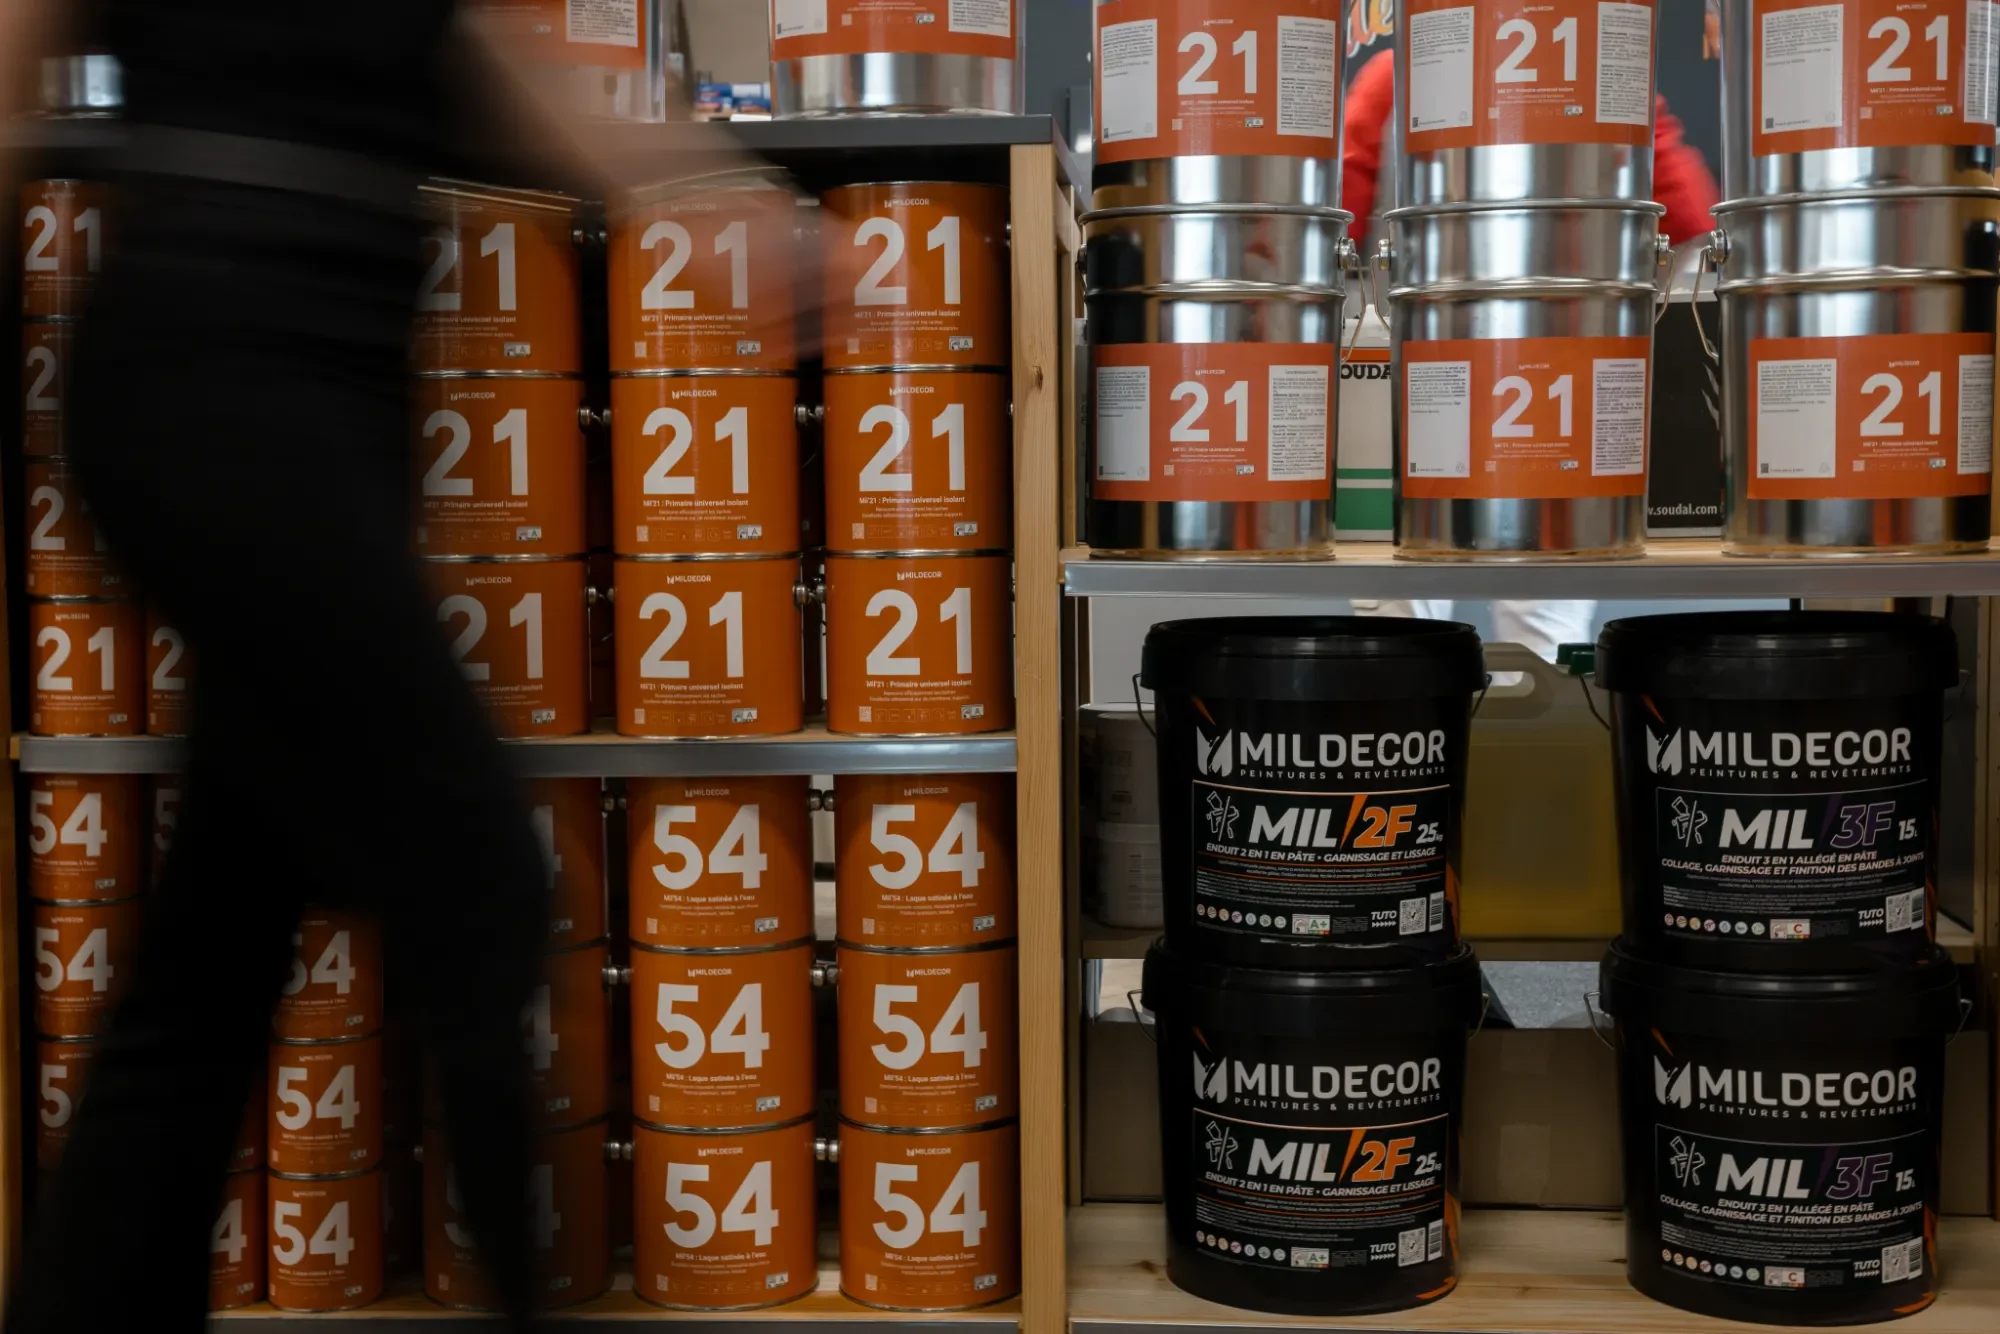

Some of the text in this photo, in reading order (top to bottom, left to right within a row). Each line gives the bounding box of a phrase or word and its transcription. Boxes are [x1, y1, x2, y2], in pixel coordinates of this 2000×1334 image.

[1177, 30, 1257, 95] 21
[1495, 17, 1577, 84] 21
[1867, 15, 1949, 83] 21
[24, 205, 100, 272] 21
[854, 216, 961, 306] 21
[417, 222, 516, 311] 21
[640, 220, 748, 310] 21
[26, 346, 59, 410] 2
[897, 386, 934, 394] MILDECOR
[1170, 380, 1248, 442] 21
[1492, 374, 1573, 438] 21
[1860, 371, 1941, 436] 21
[422, 408, 528, 496] 21
[642, 407, 749, 494] 21
[858, 403, 965, 492] 21
[665, 499, 693, 507] Primaire
[905, 571, 942, 579] MILDECOR
[436, 592, 543, 681] 21
[639, 591, 744, 678] 21
[866, 588, 972, 675] 21
[36, 626, 115, 691] 21
[152, 627, 186, 691] 2
[951, 679, 972, 687] isolant
[1240, 730, 1446, 768] MILDECOR
[1689, 727, 1911, 767] MILDECOR
[912, 787, 948, 795] MILDECOR
[1241, 769, 1326, 780] PEINTURES
[1354, 766, 1445, 779] REVÊTEMENTS
[1690, 764, 1911, 779] PEINTURES & REVÊTEMENTS
[29, 790, 108, 857] 54
[652, 804, 767, 890] 54
[868, 802, 985, 890] 54
[1718, 809, 1815, 849] MIL
[1830, 801, 1896, 848] 3F
[1206, 843, 1437, 863] ENDUIT 2 EN 1 EN PÂTE GARNISSAGE ET LISSAGE
[1661, 858, 1703, 873] COLLAGE,
[1705, 864, 1771, 876] GARNISSAGE
[1773, 865, 1786, 875] ET
[1788, 864, 1835, 875] FINITION
[1837, 863, 1857, 873] DES
[1858, 860, 1895, 872] BANDES
[1721, 850, 1878, 865] ENDUIT 3 EN 1 ALLÉGÉ EN PÂTE
[905, 895, 926, 903] Laque
[1371, 910, 1397, 921] TUTO
[1858, 908, 1884, 921] TUTO
[1309, 920, 1327, 929] A+
[1793, 923, 1803, 934] C
[35, 927, 114, 992] 54
[915, 968, 951, 976] MILDECOR
[655, 983, 770, 1069] 54
[871, 982, 987, 1070] 54
[40, 1064, 73, 1128] 5
[276, 1064, 360, 1130] 54
[688, 1074, 709, 1082] Laque
[1234, 1057, 1441, 1099] MILDECOR
[1234, 1097, 1319, 1111] PEINTURES
[1348, 1093, 1441, 1110] REVÊTEMENTS
[1698, 1066, 1916, 1107] MILDECOR
[1700, 1103, 1789, 1118] PEINTURES
[1819, 1102, 1917, 1119] REVÊTEMENTS
[706, 1147, 743, 1155] MILDECOR
[1205, 1171, 1436, 1197] ENDUIT 2 EN 1 EN PÂTE GARNISSAGE ET LISSAGE
[1715, 1153, 1810, 1199] MIL
[1826, 1152, 1893, 1200] 3F
[663, 1160, 779, 1248] 54
[873, 1161, 987, 1249] 54
[1660, 1194, 1700, 1213] COLLAGE,
[1702, 1205, 1767, 1222] GARNISSAGE
[1769, 1213, 1782, 1223] ET
[1784, 1215, 1830, 1225] FINITION
[1833, 1214, 1853, 1224] DES
[1854, 1210, 1891, 1222] BANDES
[1718, 1199, 1874, 1214] ENDUIT 3 EN 1 ALLÉGÉ EN PÂTE
[210, 1198, 247, 1263] 4
[272, 1200, 354, 1266] 54
[1370, 1242, 1396, 1254] TUTO
[1309, 1252, 1326, 1263] A+
[1788, 1272, 1797, 1282] C
[1854, 1259, 1880, 1270] TUTO
